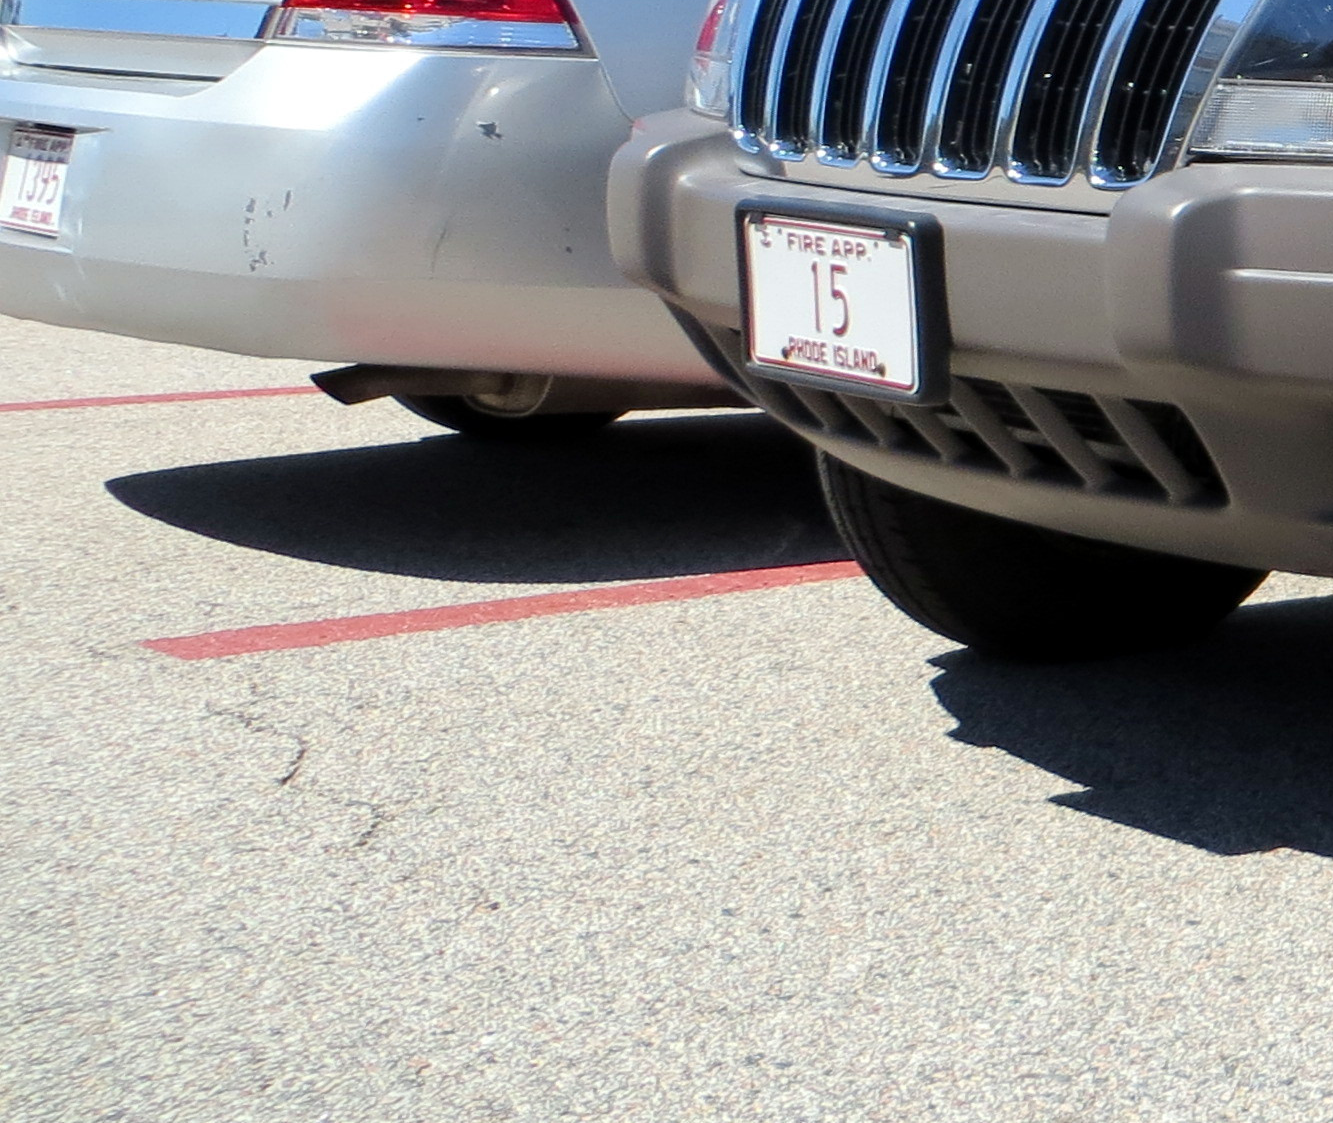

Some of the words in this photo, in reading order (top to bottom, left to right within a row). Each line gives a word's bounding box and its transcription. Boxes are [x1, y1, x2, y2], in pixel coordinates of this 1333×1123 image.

[787, 232, 826, 255] FIRE
[811, 260, 850, 336] 15
[788, 336, 828, 363] RHODE
[833, 345, 878, 371] ISLAND
